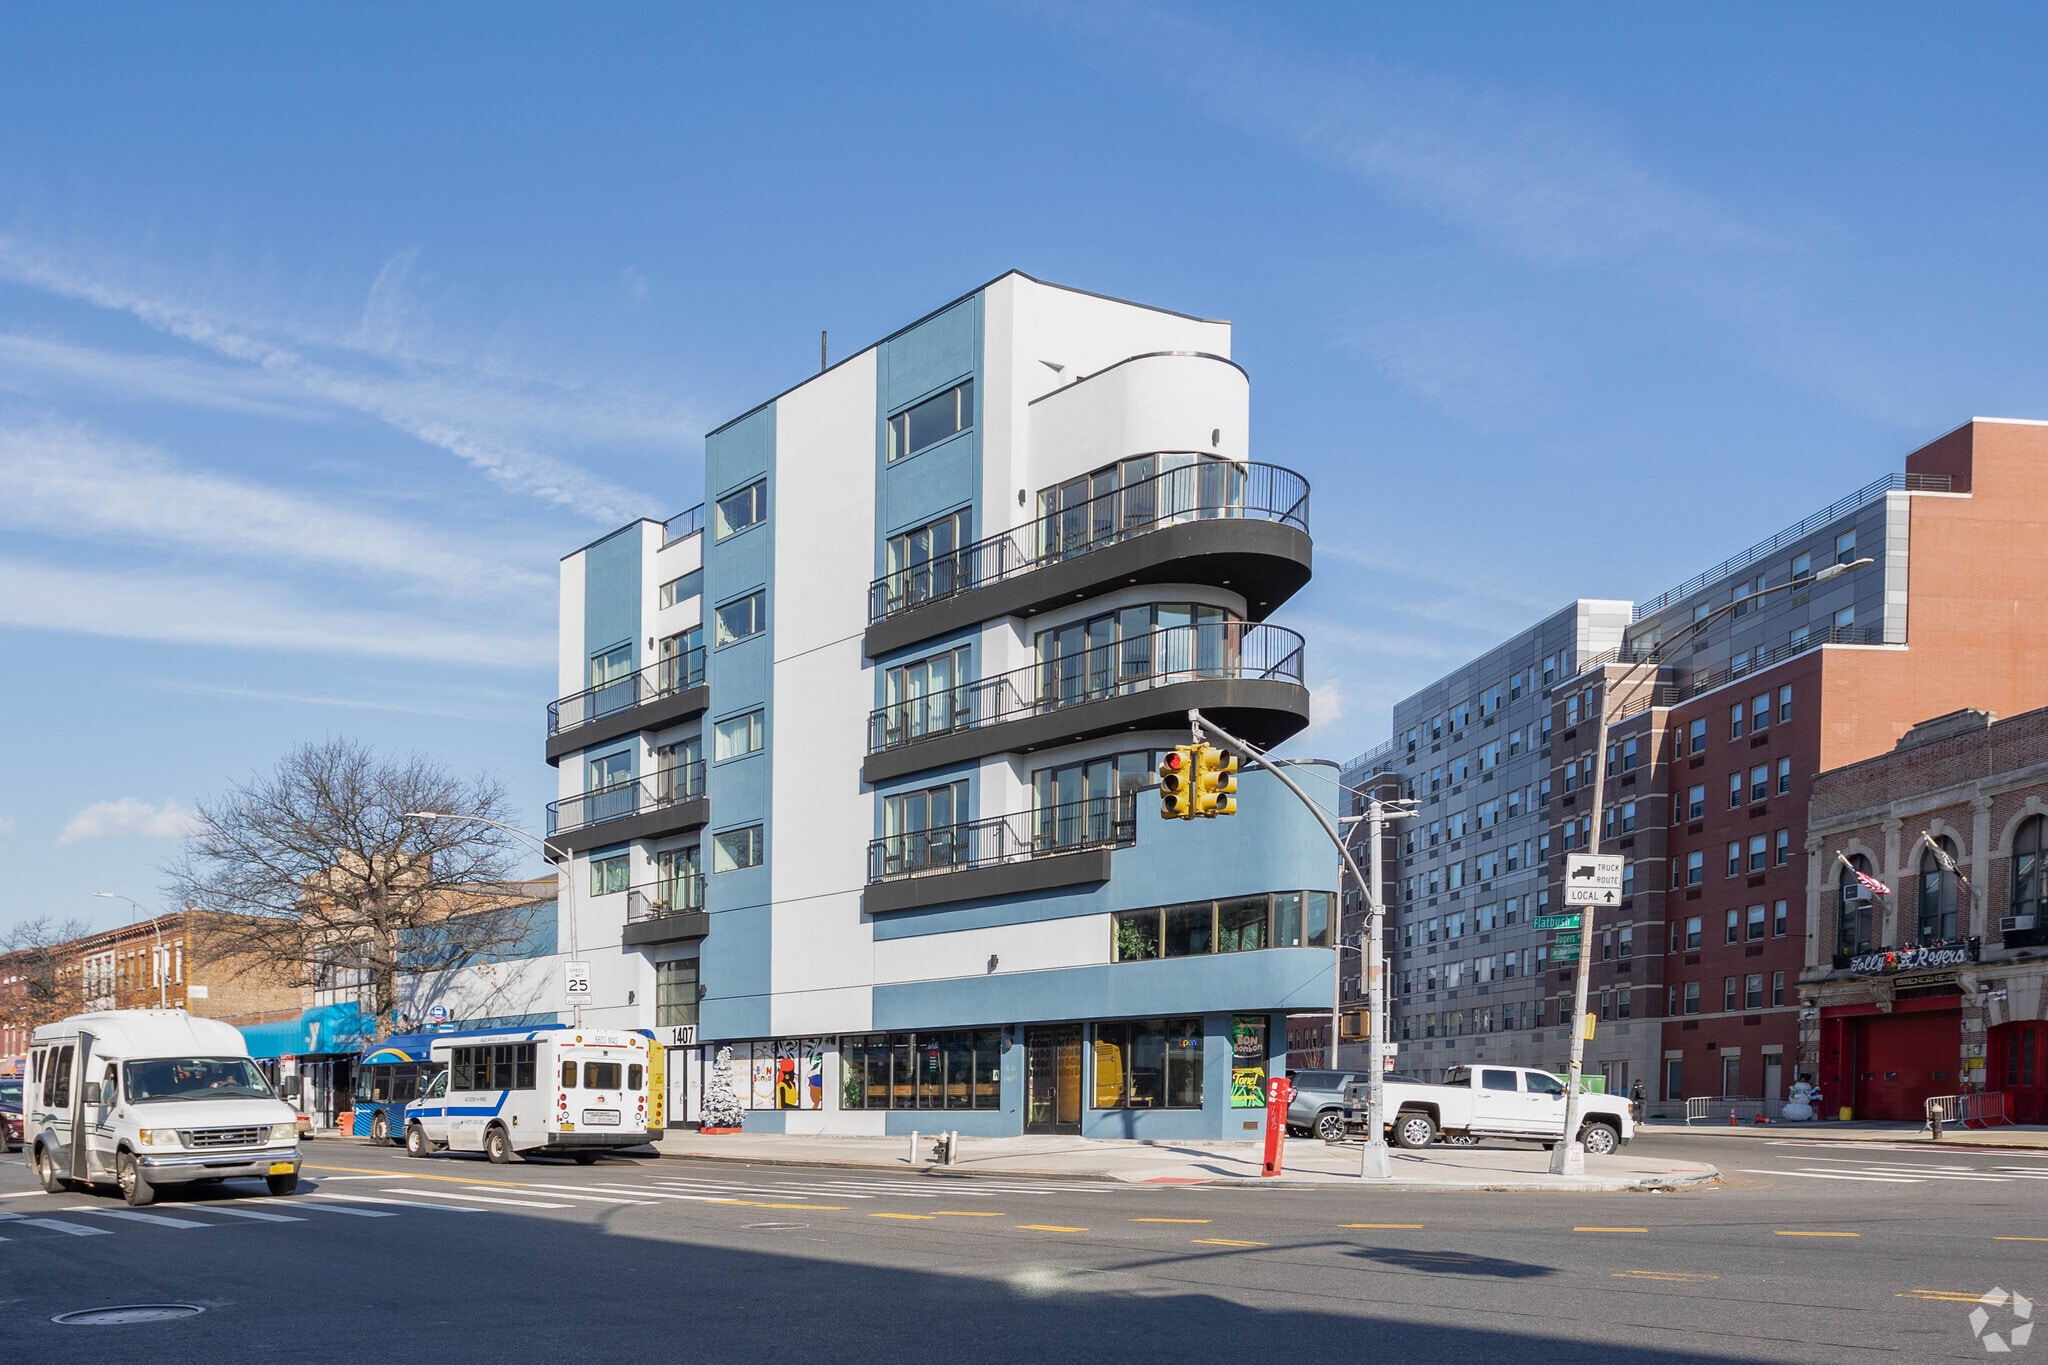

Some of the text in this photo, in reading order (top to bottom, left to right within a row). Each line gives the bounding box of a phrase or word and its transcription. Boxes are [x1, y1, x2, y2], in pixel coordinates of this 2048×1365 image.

[1598, 863, 1620, 872] TRUCK
[1596, 876, 1619, 885] ROUTE
[1572, 891, 1599, 901] LOCAL
[1533, 917, 1570, 928] Flatbush
[1915, 949, 1967, 968] Rogers
[568, 979, 588, 992] 25
[672, 1026, 694, 1045] 1407
[1237, 1035, 1258, 1046] BON
[1233, 1043, 1263, 1053] Bonbon
